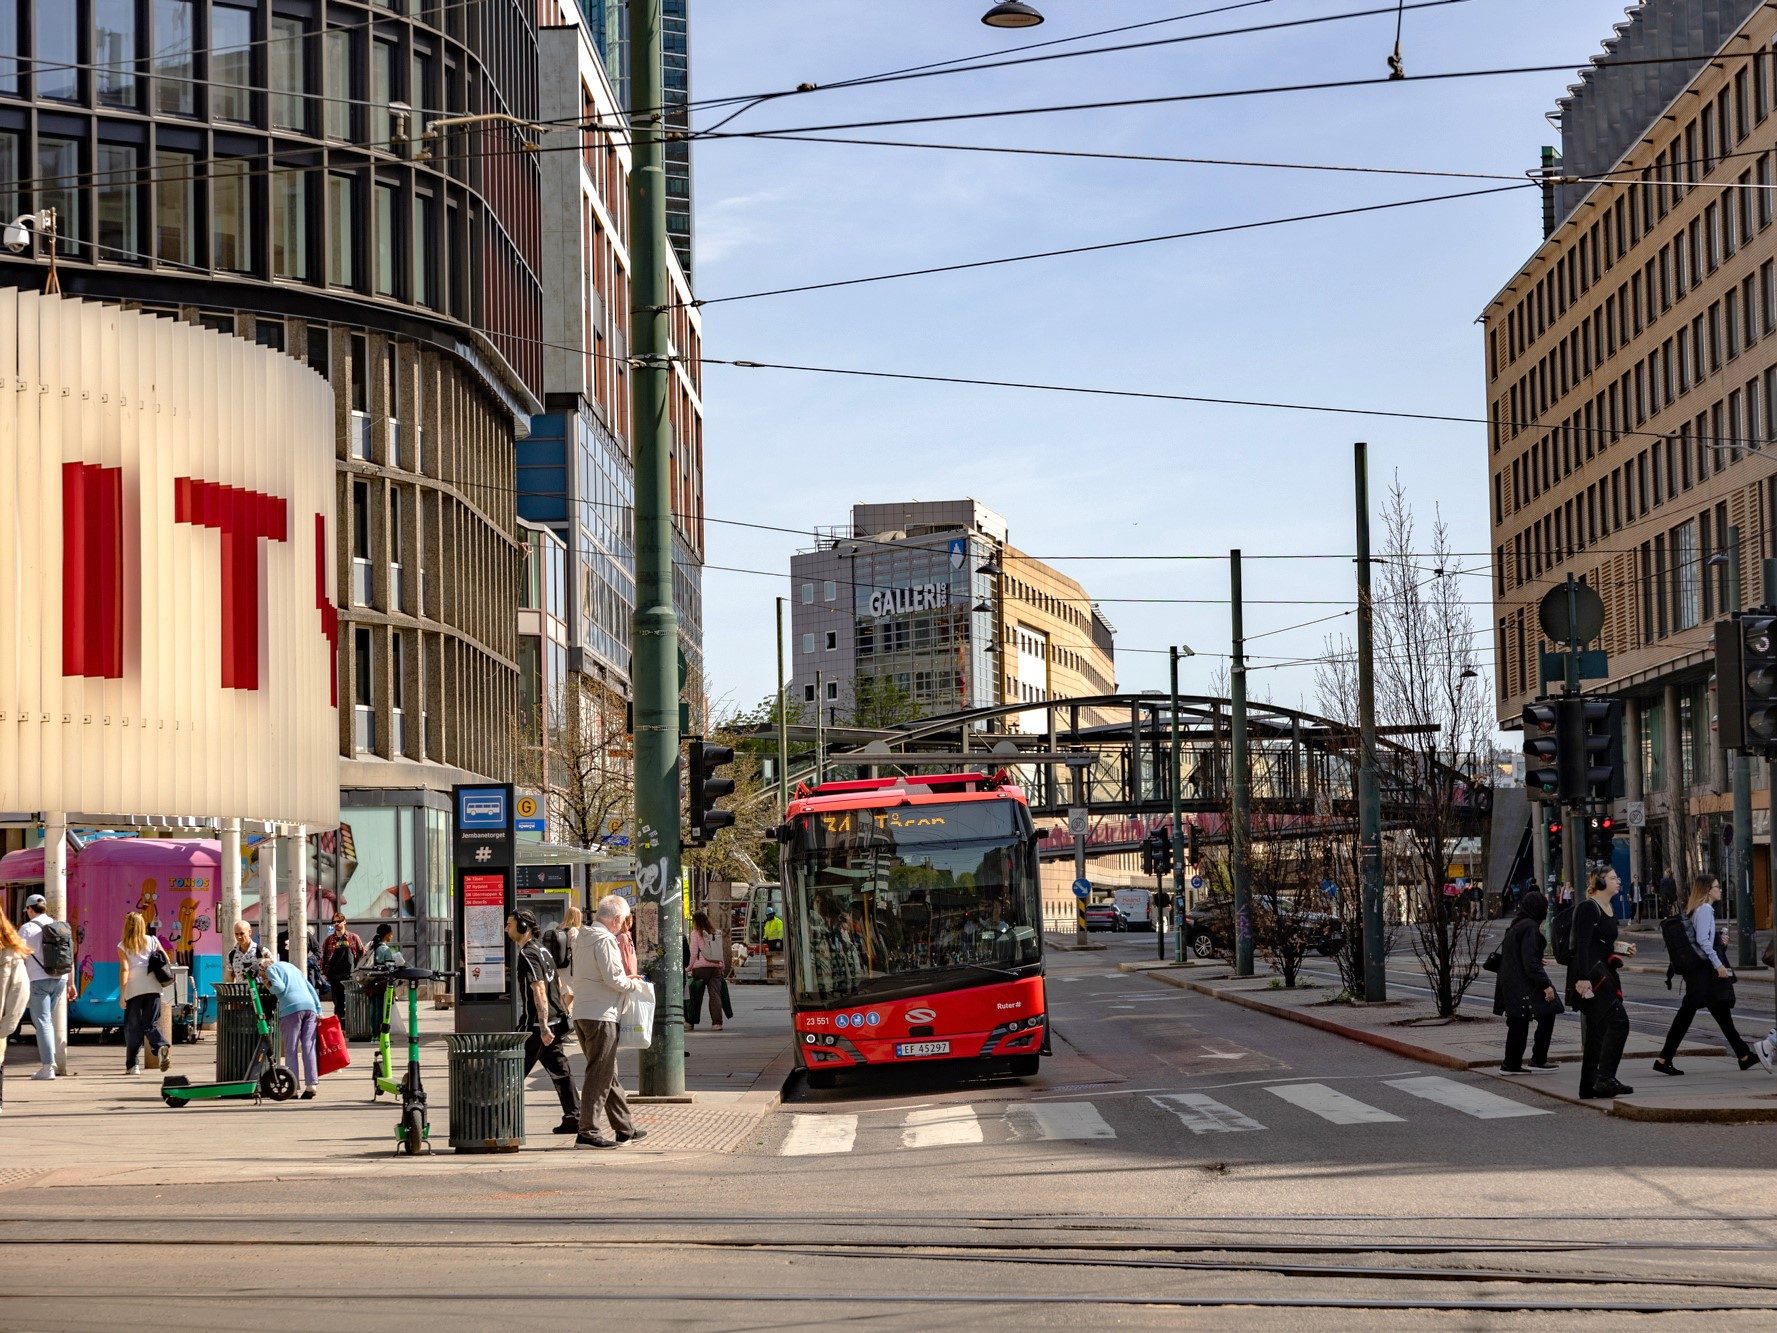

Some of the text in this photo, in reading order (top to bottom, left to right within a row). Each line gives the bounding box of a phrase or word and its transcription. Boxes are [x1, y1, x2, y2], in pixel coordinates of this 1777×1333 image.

[869, 582, 941, 617] GALLERI
[522, 800, 531, 813] G
[461, 832, 506, 840] Jernbanetorget
[806, 1017, 829, 1026] 23 551
[904, 1043, 947, 1054] EF 45297
